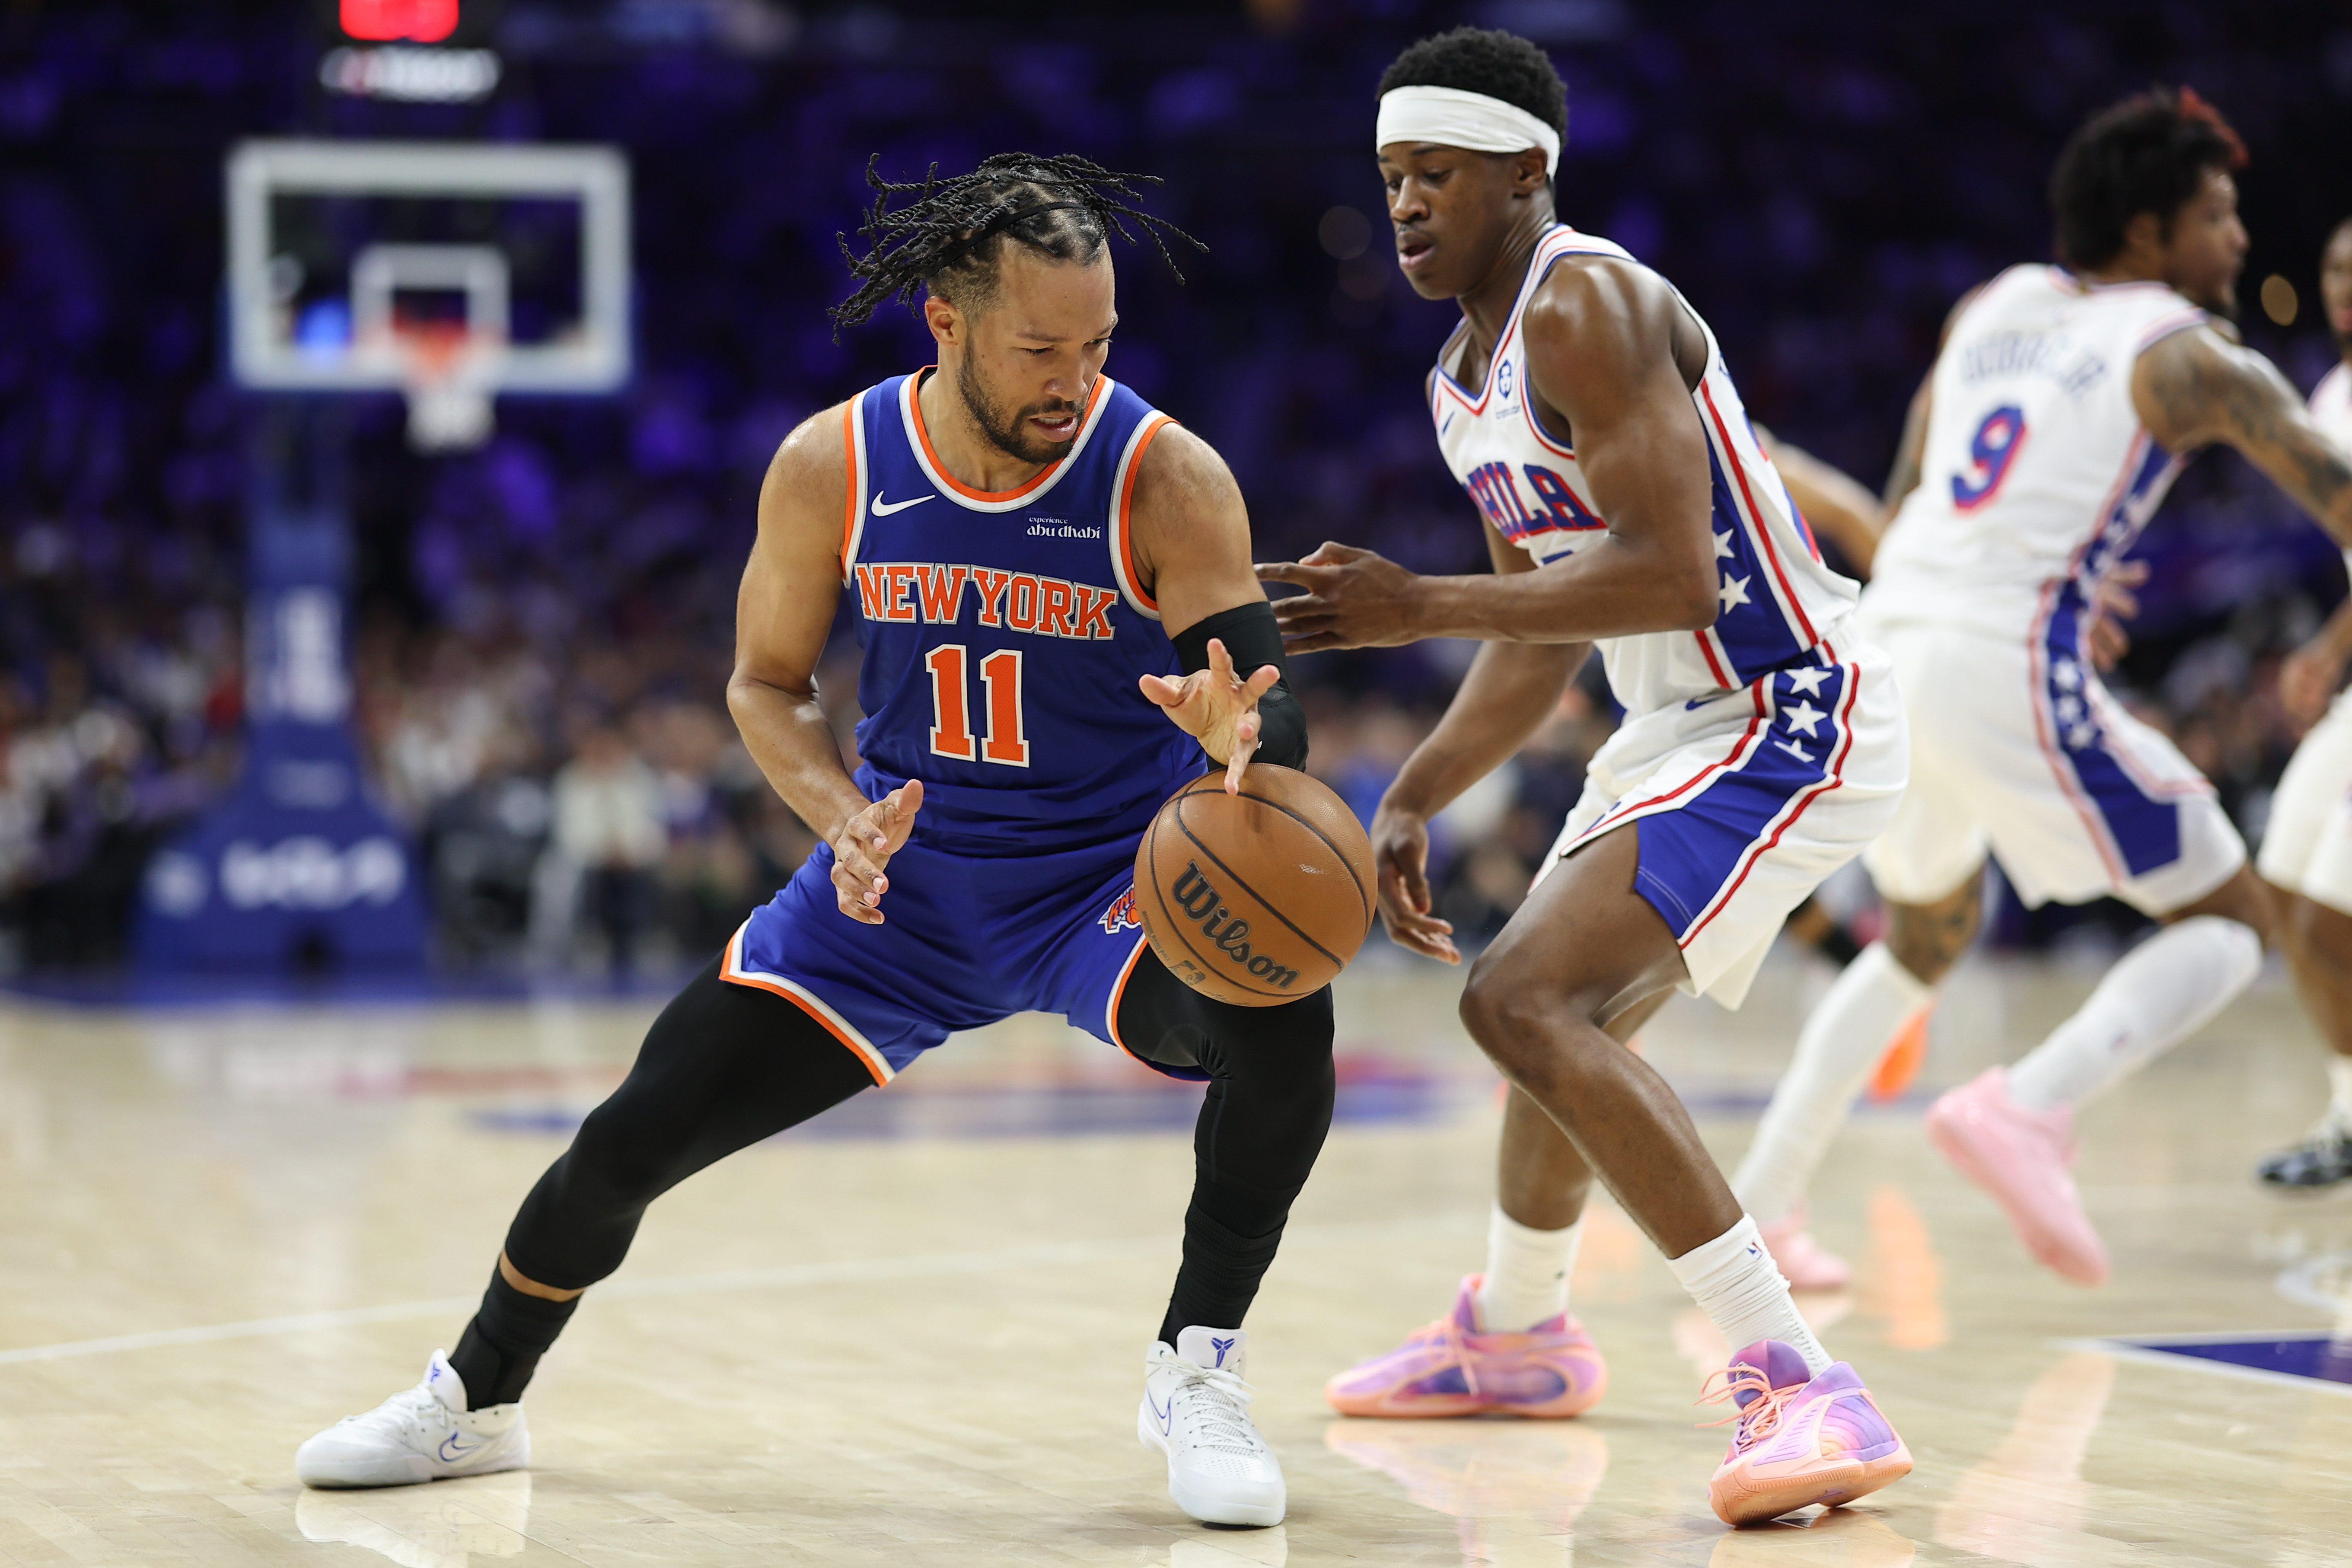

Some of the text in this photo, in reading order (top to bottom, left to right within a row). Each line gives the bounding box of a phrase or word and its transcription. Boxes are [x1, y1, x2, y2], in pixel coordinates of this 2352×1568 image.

[1462, 462, 1609, 545] HILA
[1951, 404, 2029, 515] 9
[1027, 523, 1101, 539] abu dhabi
[854, 562, 1119, 641] NEW YORK
[925, 644, 1029, 768] 11
[1173, 860, 1300, 989] Wilson
